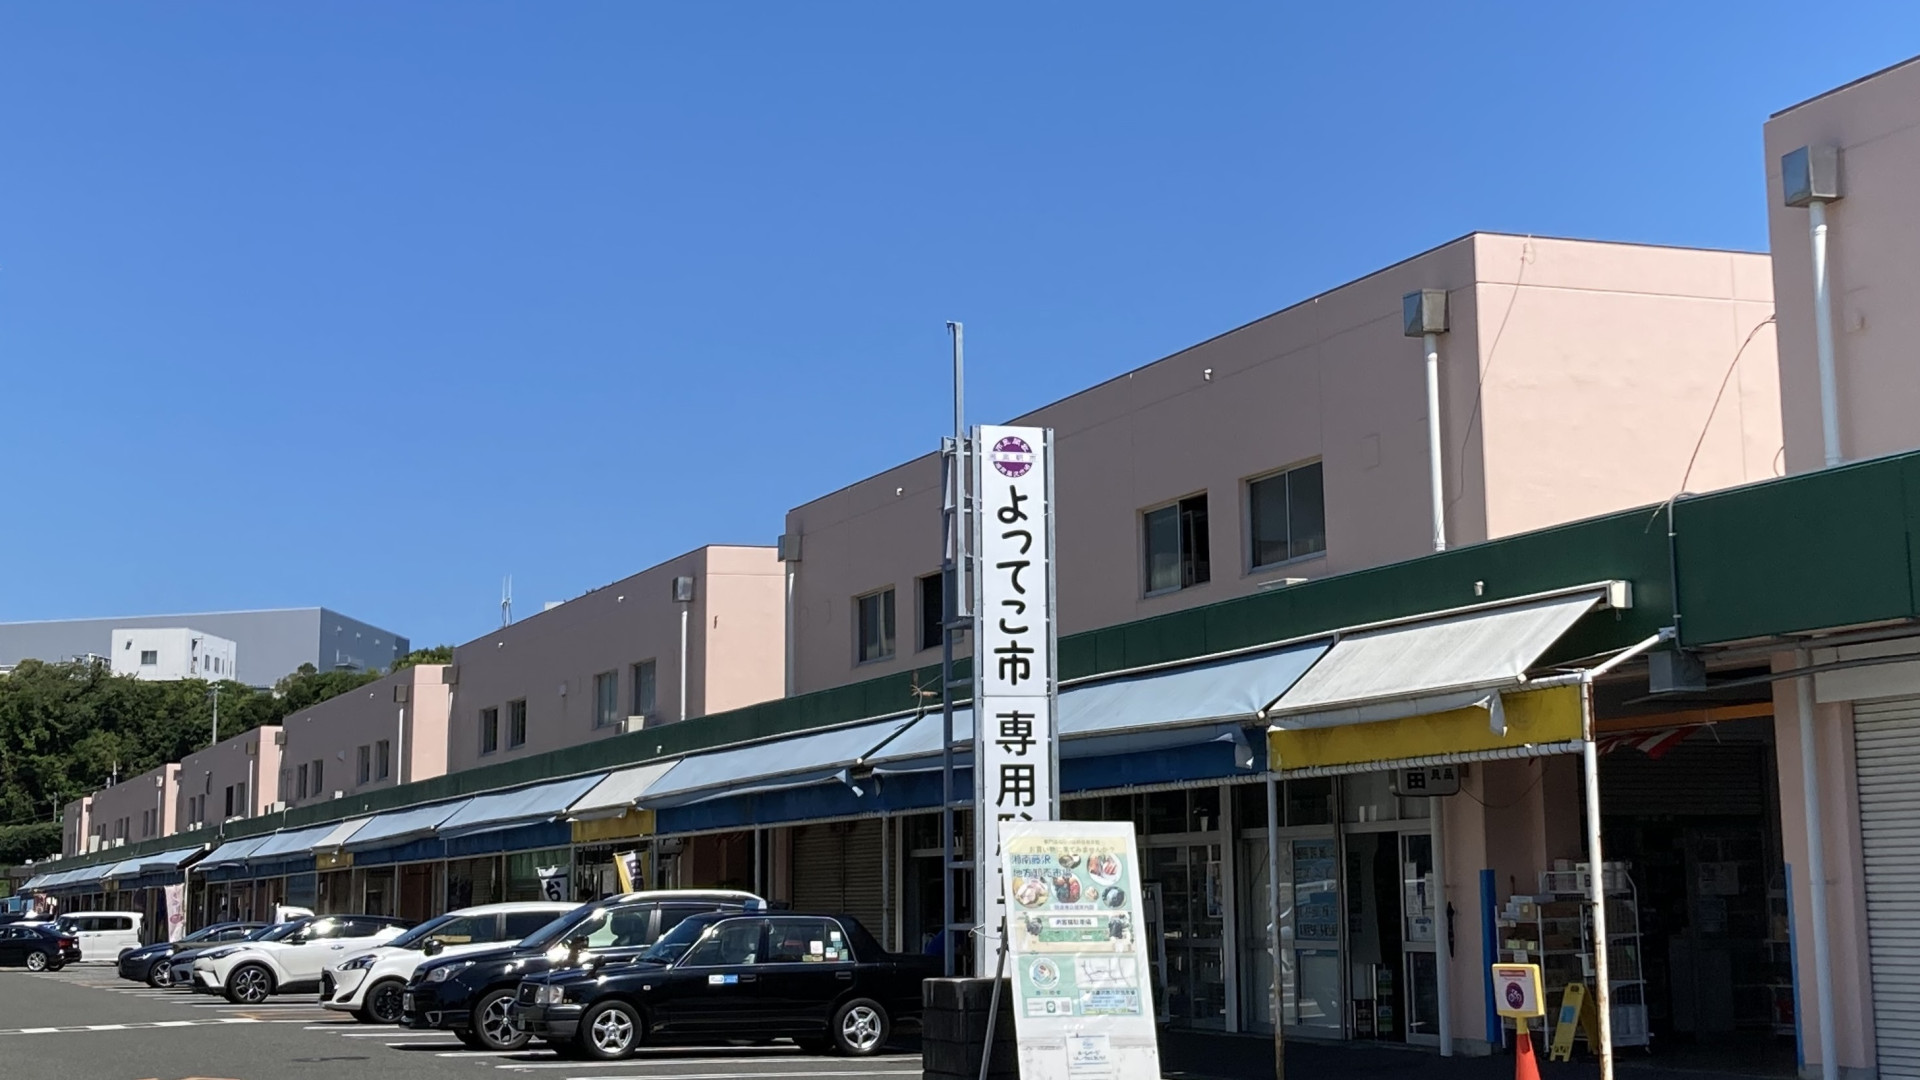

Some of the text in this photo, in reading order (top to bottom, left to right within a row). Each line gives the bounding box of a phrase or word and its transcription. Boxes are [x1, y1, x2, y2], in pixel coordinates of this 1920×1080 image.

[994, 485, 1035, 686] よってこ市
[1012, 854, 1051, 865] 湘南藤沢
[1013, 868, 1073, 878] 地方卸売市場
